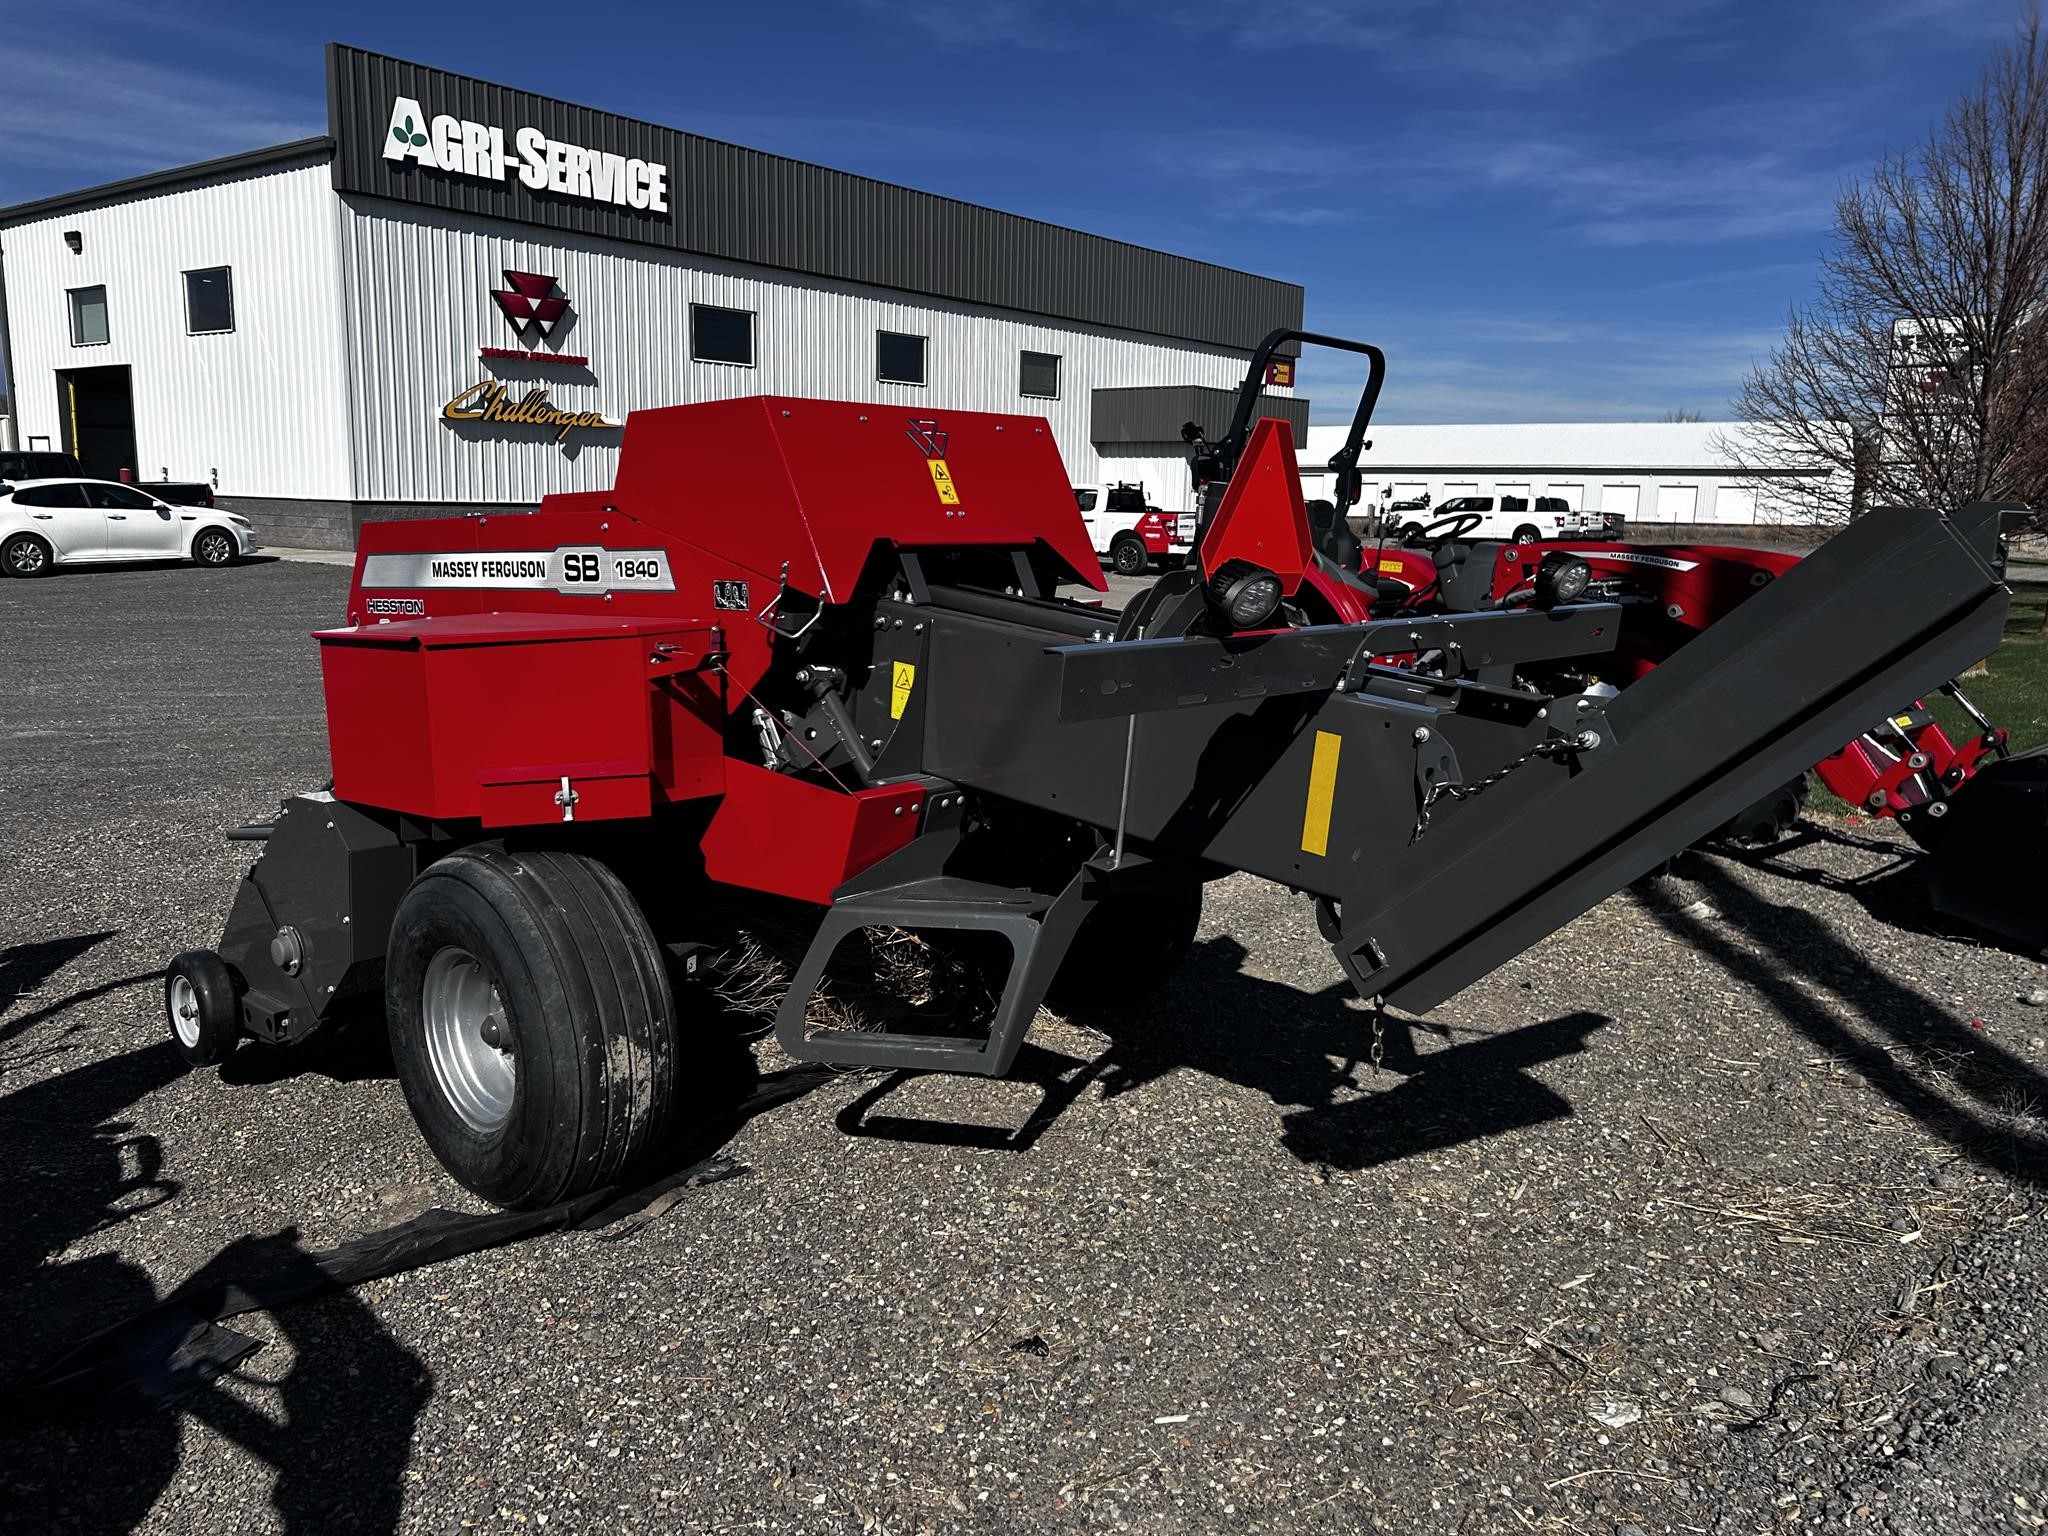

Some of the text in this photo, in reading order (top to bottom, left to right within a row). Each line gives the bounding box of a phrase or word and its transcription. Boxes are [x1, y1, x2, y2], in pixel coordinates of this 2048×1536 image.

[382, 96, 668, 213] AGRI-SERVICE
[442, 380, 624, 442] Challenger
[431, 554, 660, 583] MASSEY FERGUSON SB 1840
[1609, 552, 1680, 568] MASSEY FERGUSON
[366, 599, 424, 615] HESSTON
